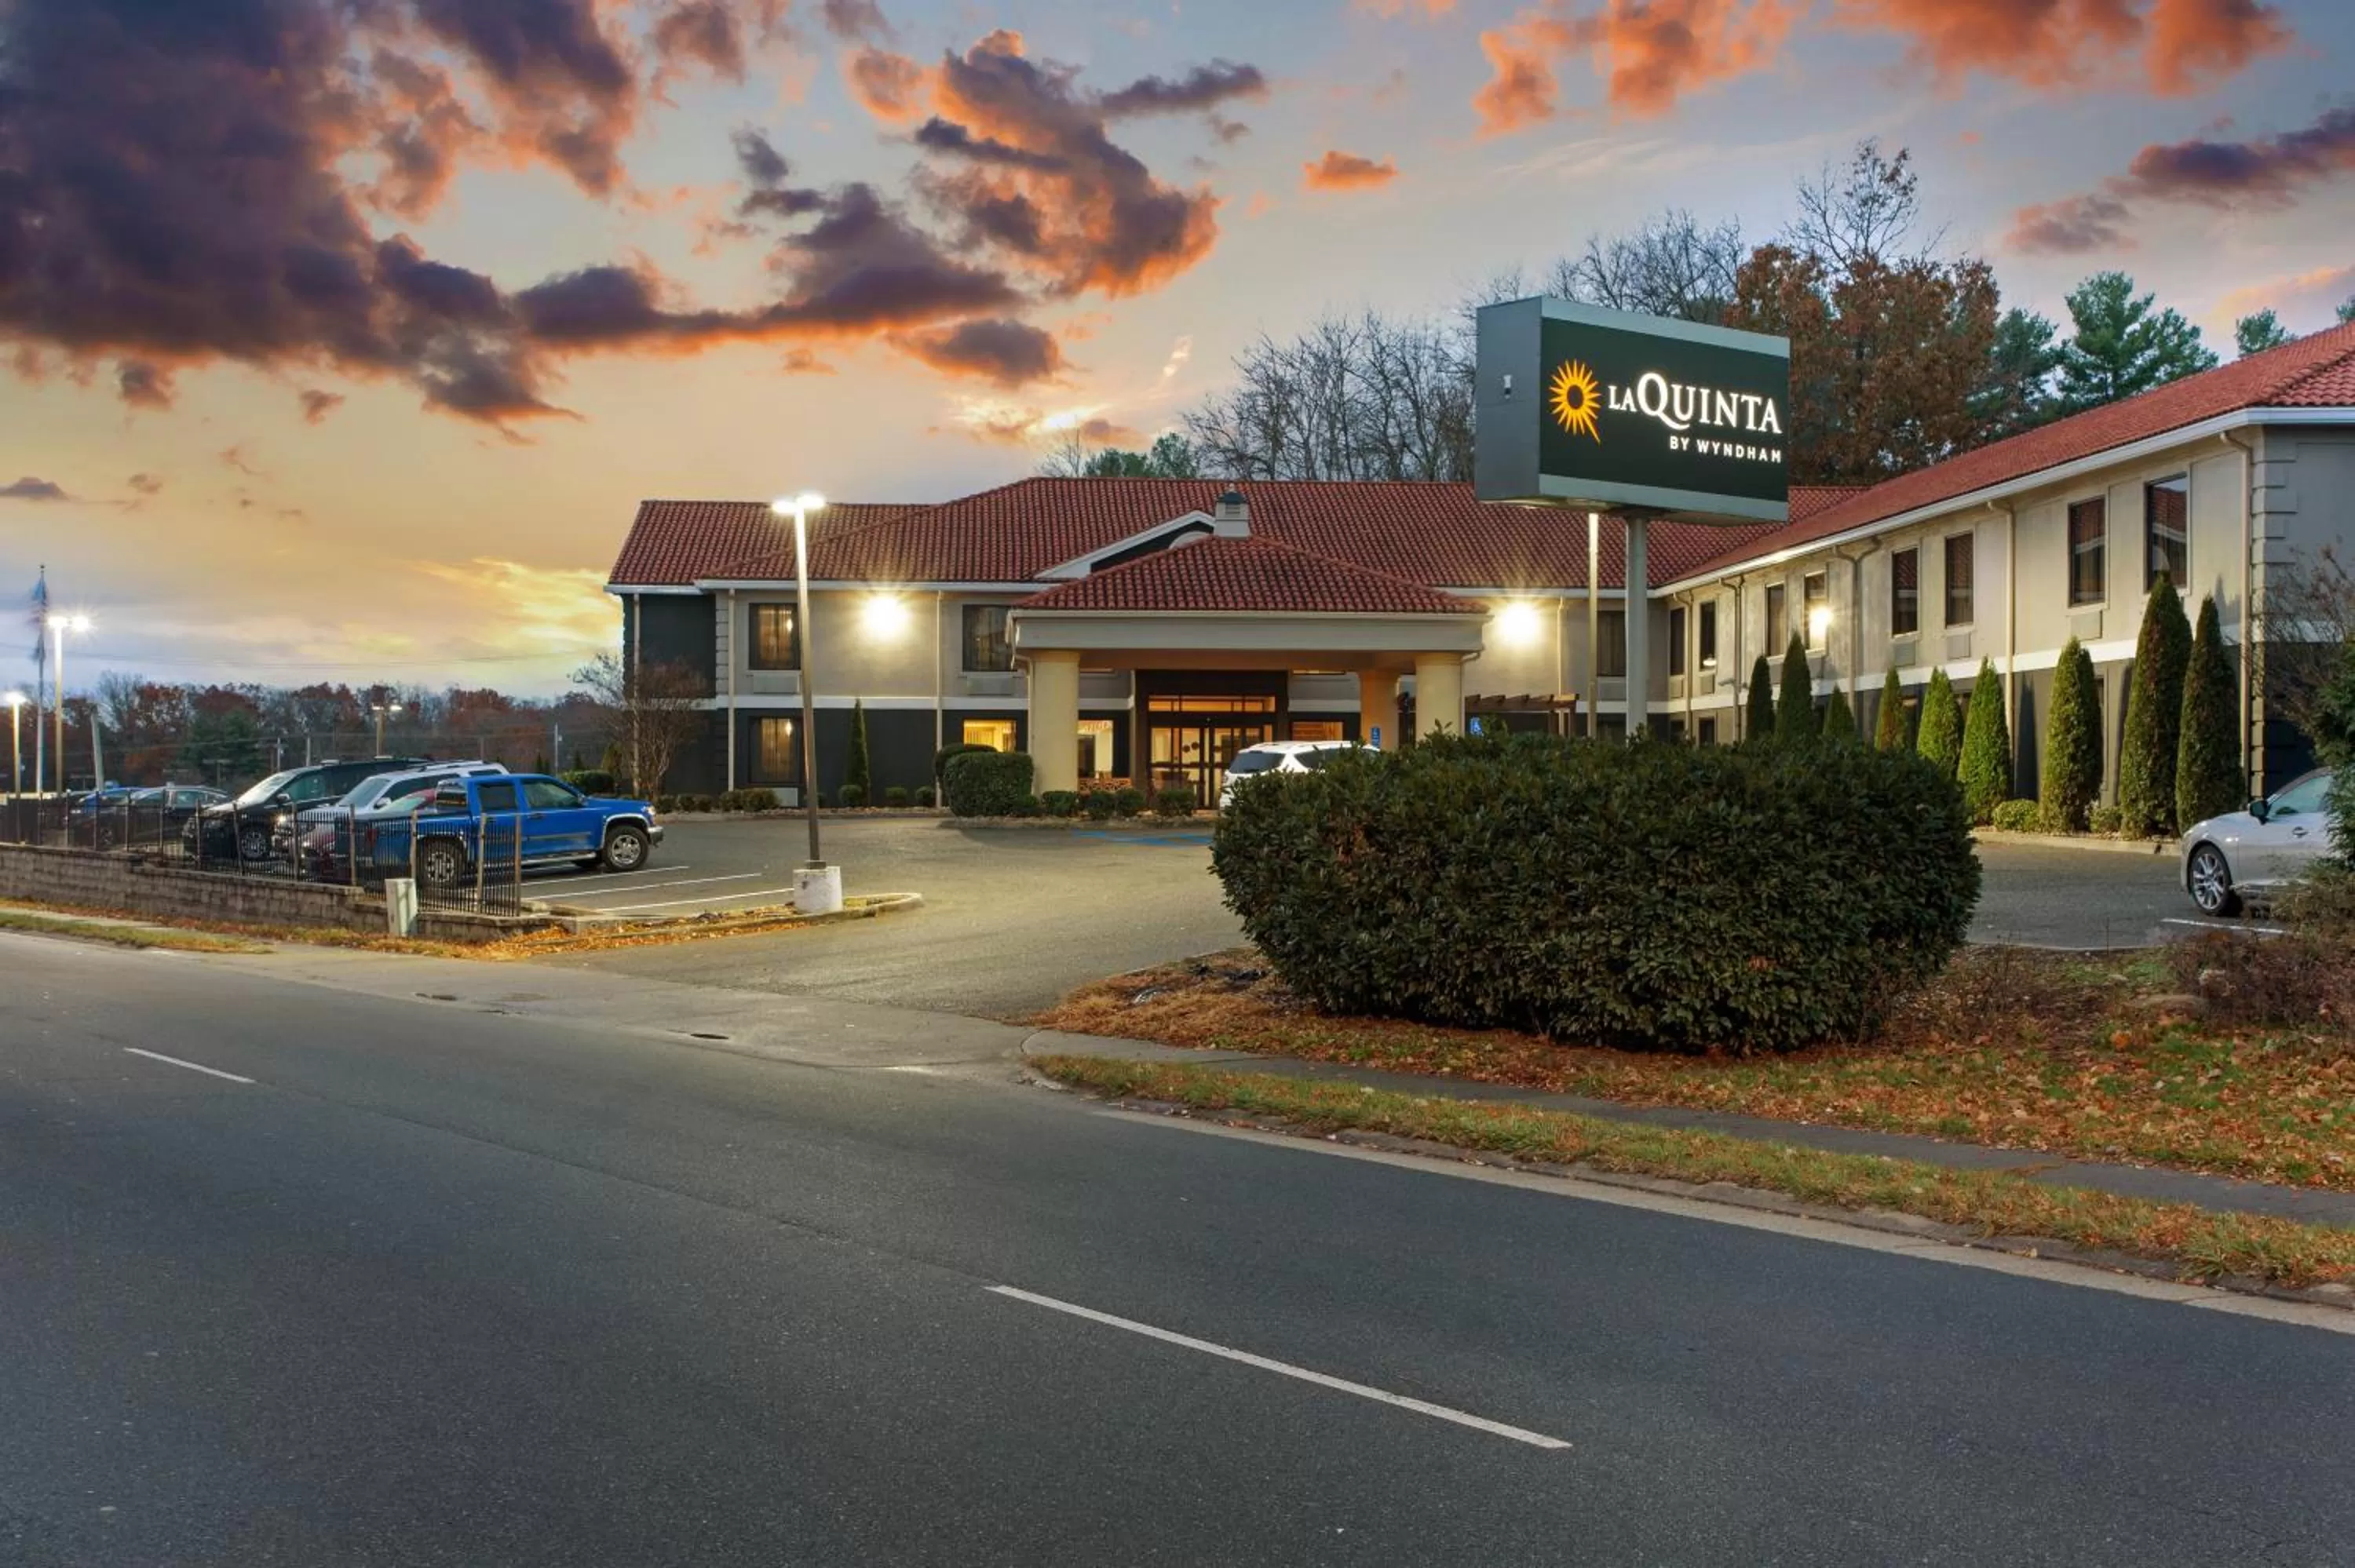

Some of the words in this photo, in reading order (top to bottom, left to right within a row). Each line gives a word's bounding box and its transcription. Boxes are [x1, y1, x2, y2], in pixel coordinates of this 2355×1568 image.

[1608, 385, 1637, 413] LA
[1637, 372, 1783, 435] QUINTA
[1669, 436, 1690, 451] BY
[1696, 439, 1782, 464] WYNDHAM
